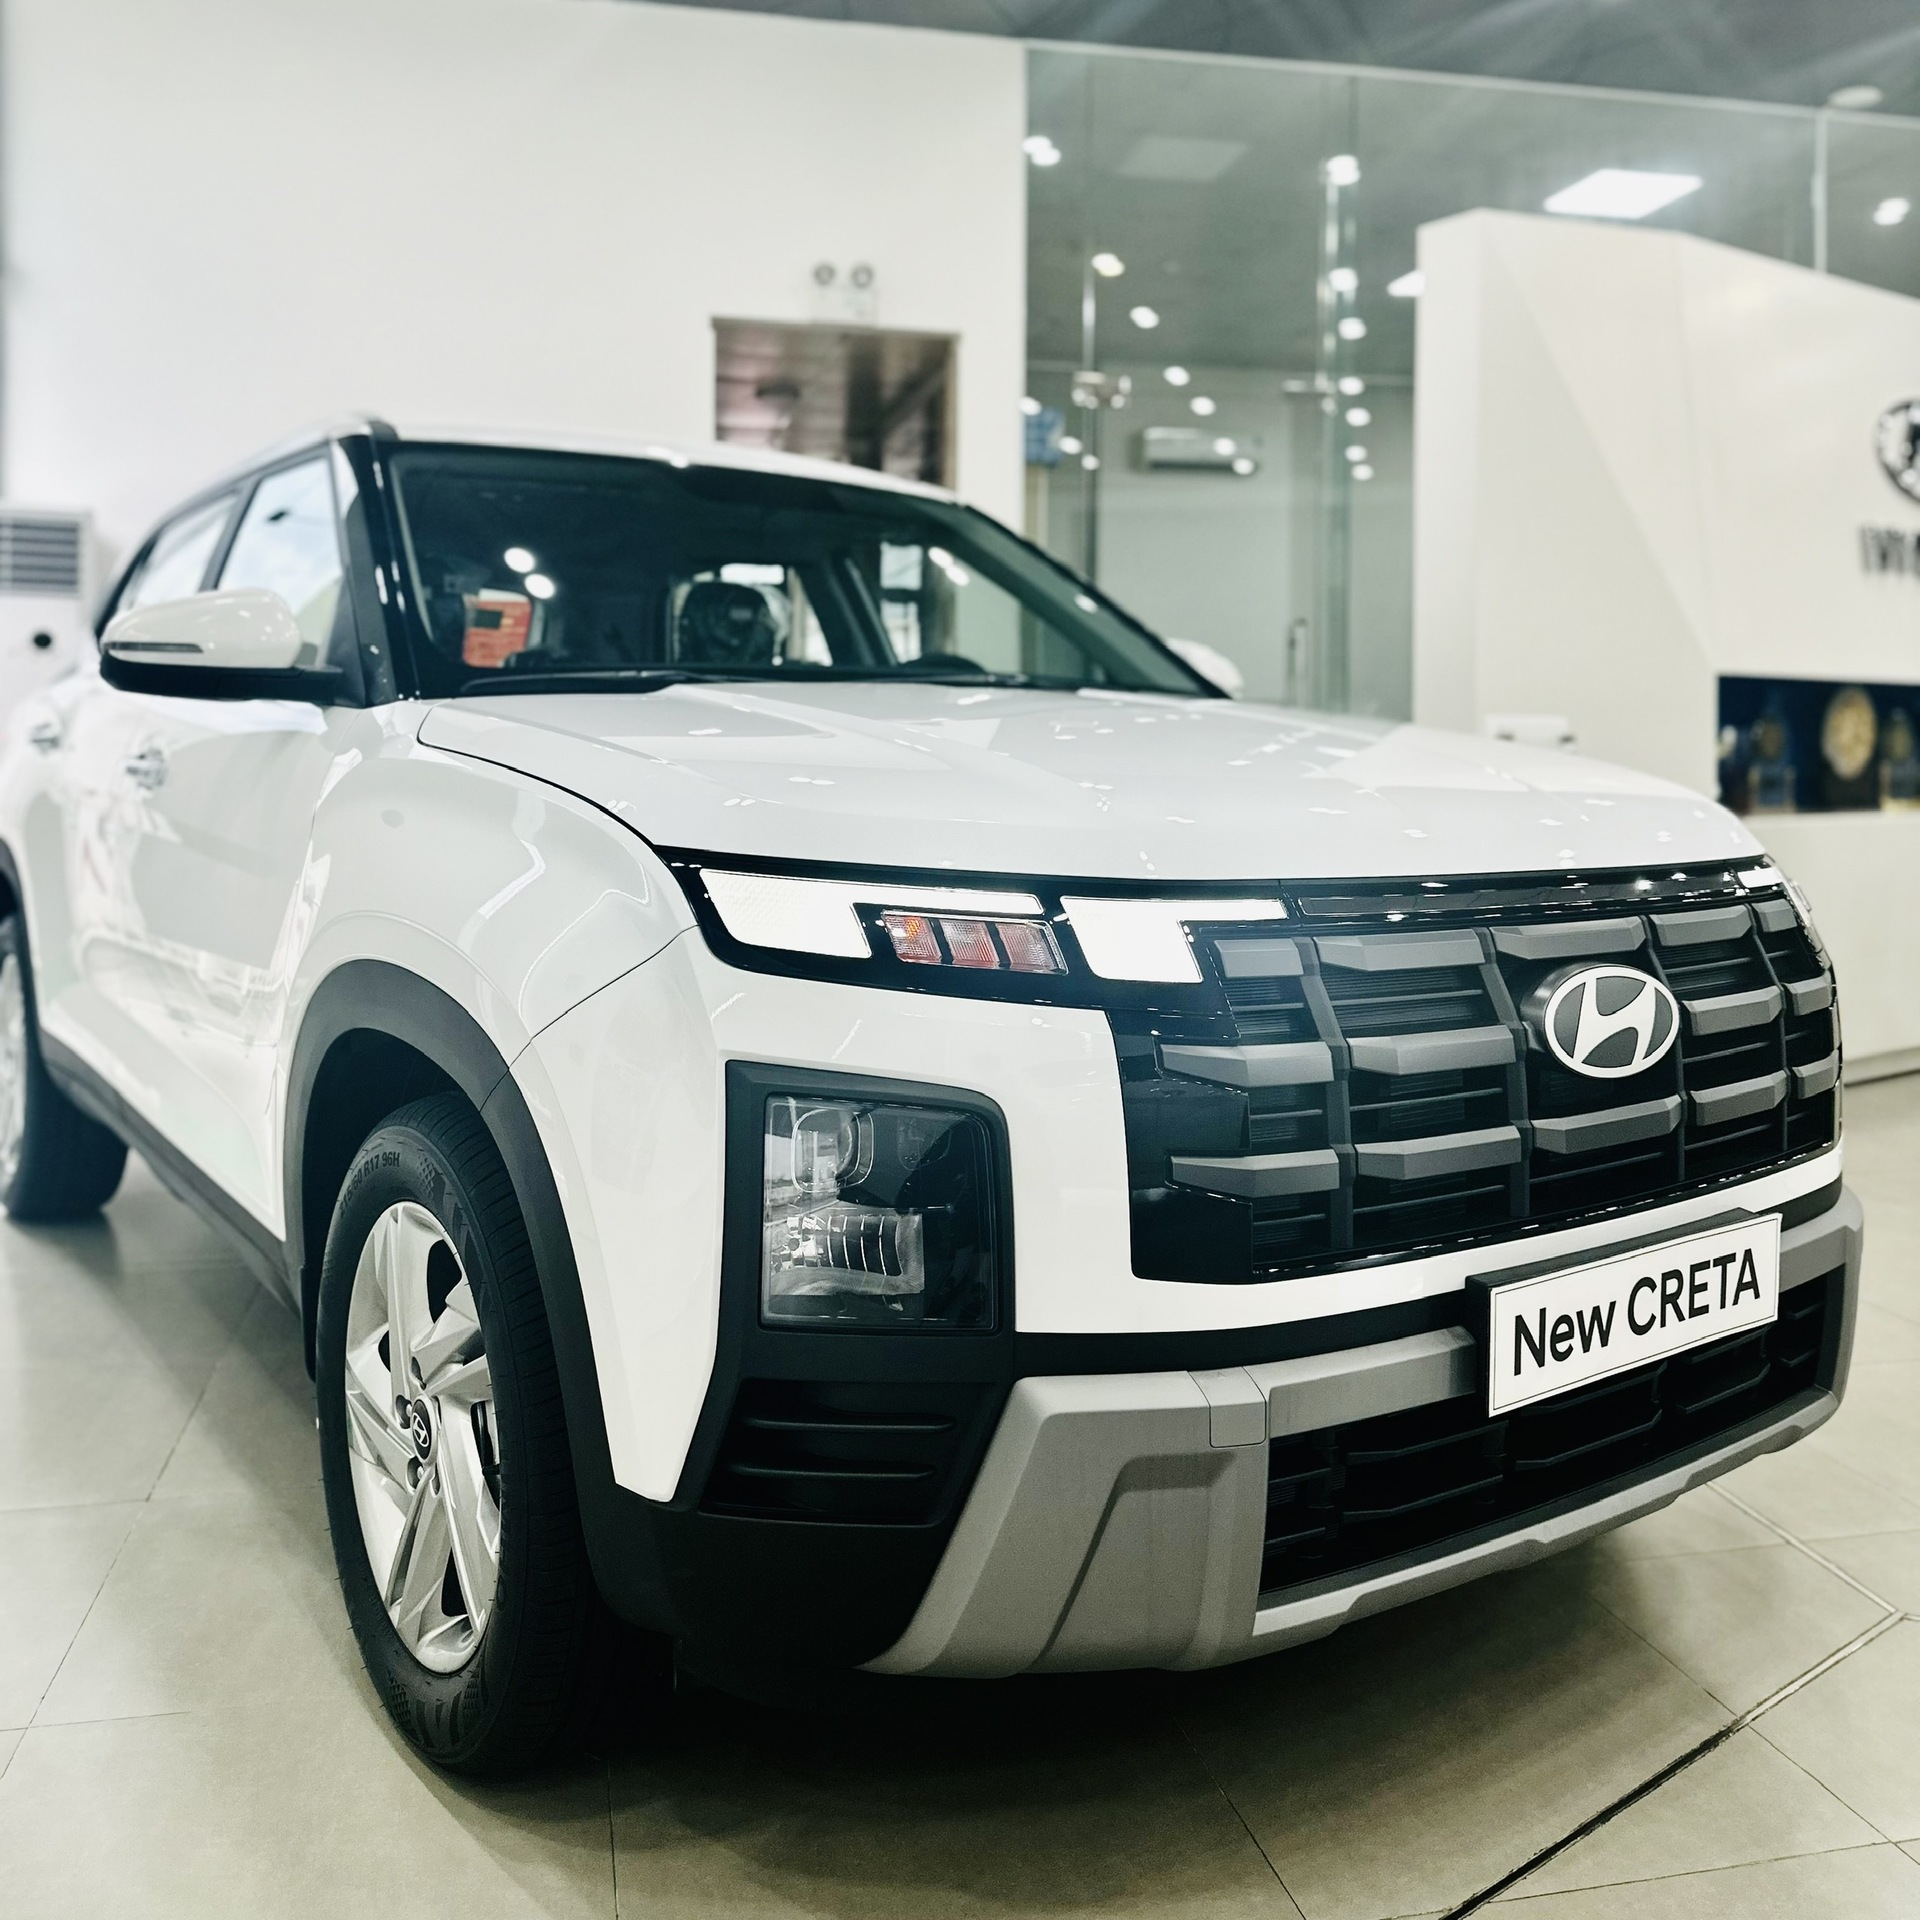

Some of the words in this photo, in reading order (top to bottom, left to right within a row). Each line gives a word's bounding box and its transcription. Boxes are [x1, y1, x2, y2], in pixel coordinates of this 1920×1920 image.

[363, 1153, 380, 1178] R17
[381, 1151, 400, 1168] 96H
[1513, 1300, 1617, 1376] New
[1627, 1248, 1761, 1336] CRETA
